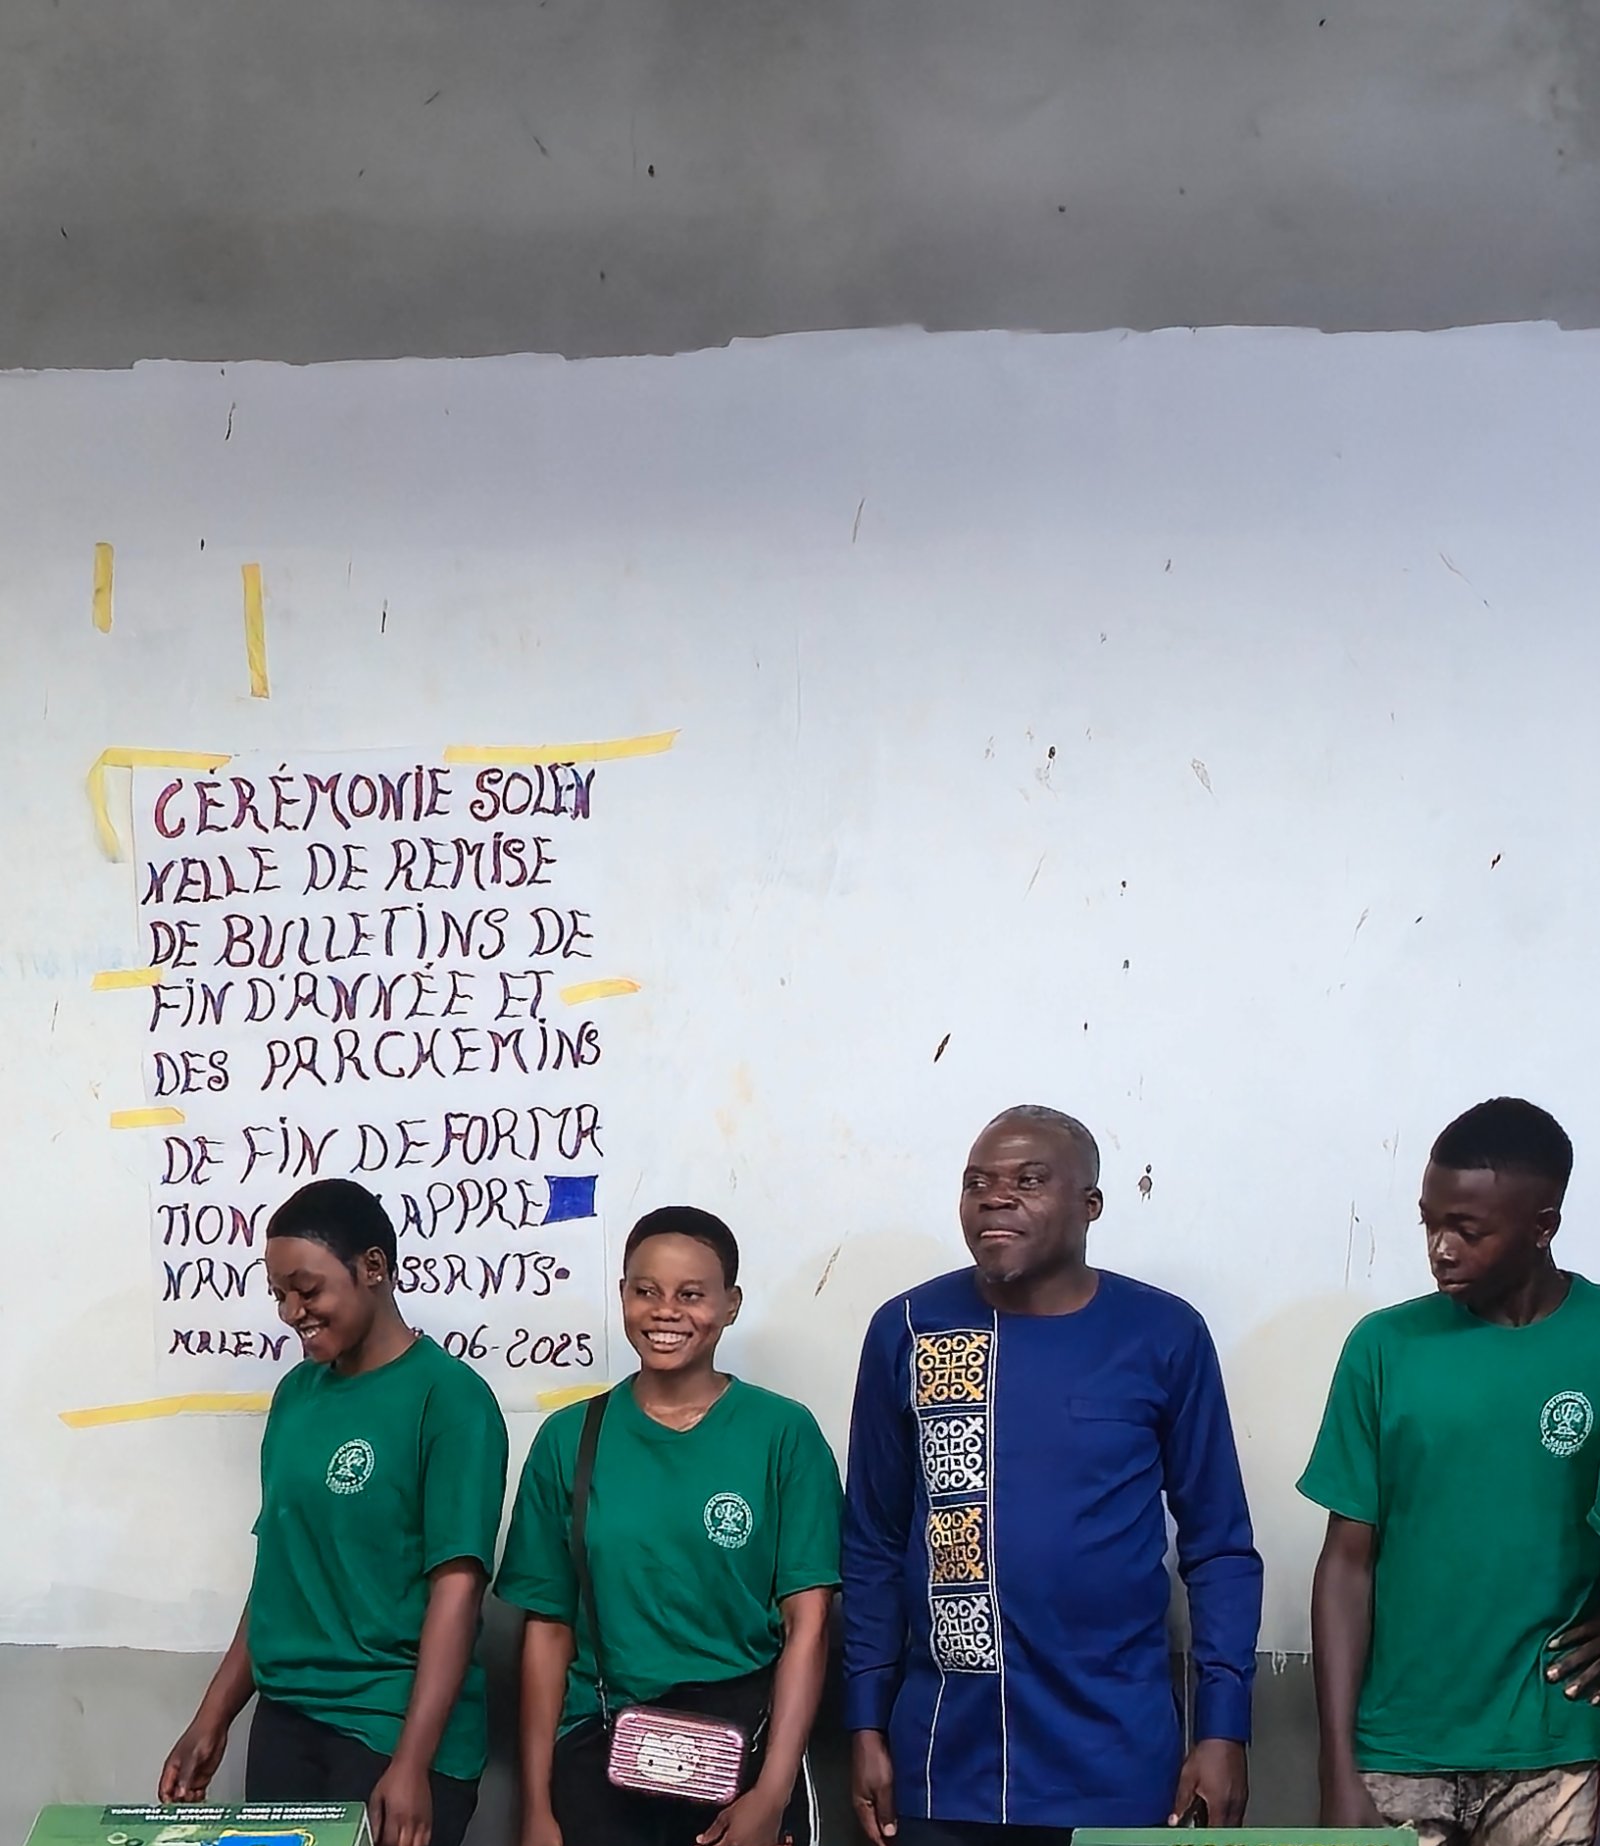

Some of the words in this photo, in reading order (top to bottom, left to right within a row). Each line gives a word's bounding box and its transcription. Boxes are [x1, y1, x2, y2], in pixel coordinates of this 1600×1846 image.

[155, 761, 453, 839] CÉRÉMONIE
[470, 761, 595, 821] SOLEN
[141, 844, 281, 905] NELLE
[303, 842, 369, 896] DE
[385, 831, 558, 891] REMISE
[150, 919, 202, 969] DE
[221, 902, 509, 969] BULLETINS
[529, 910, 594, 958] DE
[149, 977, 225, 1032] FIN
[245, 962, 474, 1024] D'ANNÉE
[498, 969, 555, 1019] ET
[154, 1050, 229, 1096] DES
[261, 1018, 601, 1090] PARCHEMINS
[162, 1134, 225, 1185] DE
[241, 1118, 339, 1184] FIN
[352, 1119, 430, 1173] DE
[157, 1203, 268, 1247] TION
[399, 1178, 543, 1240] APPRE
[162, 1257, 266, 1301] NAN
[394, 1252, 570, 1299] SSANTS.
